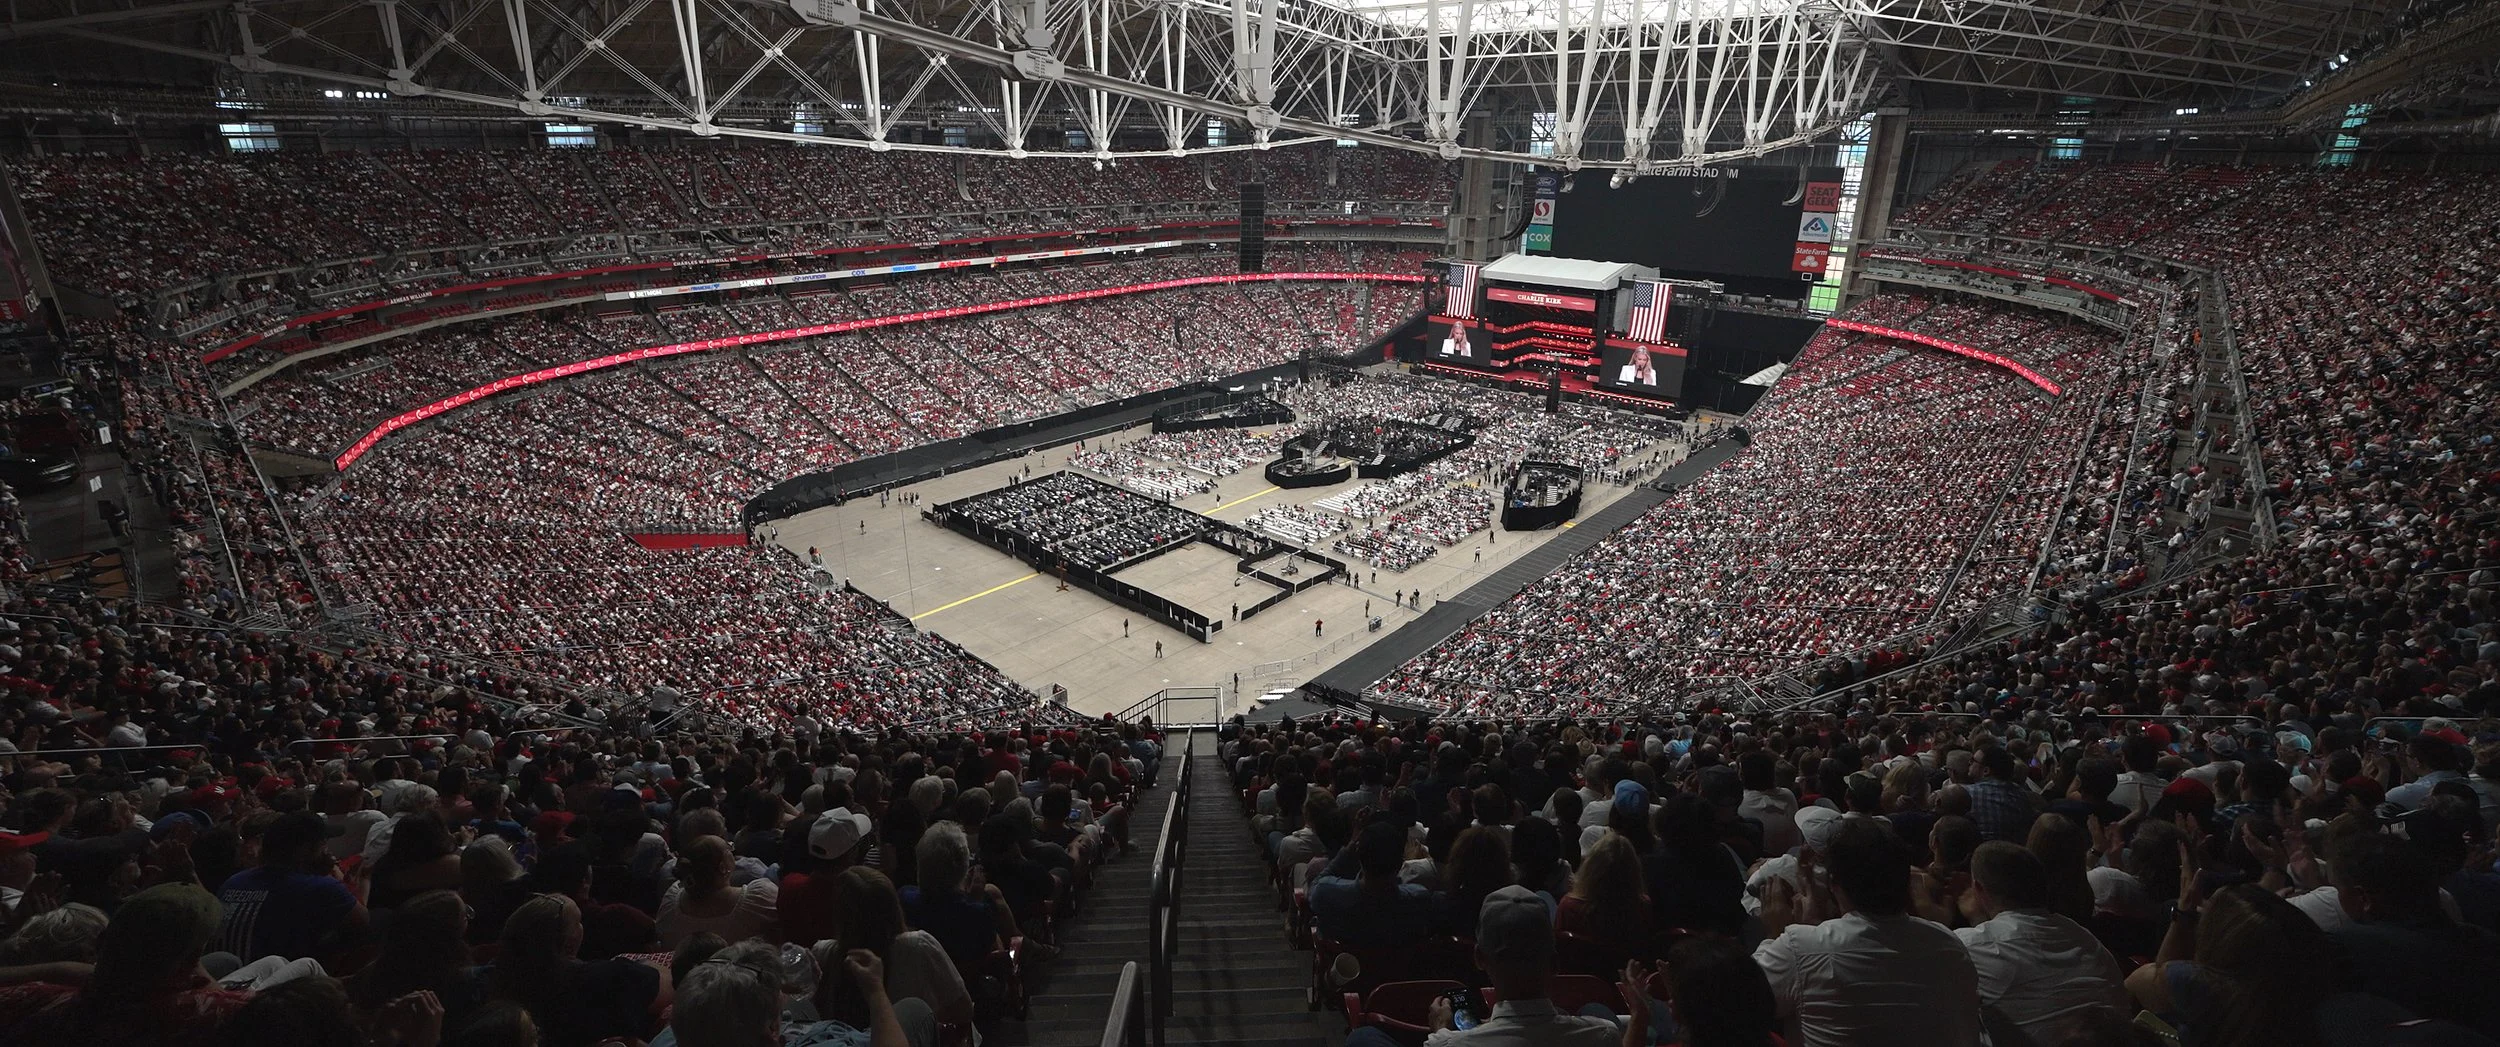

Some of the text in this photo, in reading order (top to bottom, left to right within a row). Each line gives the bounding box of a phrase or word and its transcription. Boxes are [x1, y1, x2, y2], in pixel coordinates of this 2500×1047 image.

[1692, 167, 1739, 179] STADM
[1811, 187, 1836, 196] SEAT
[1807, 197, 1835, 206] GEEK
[1529, 233, 1551, 242] COX
[410, 291, 433, 300] WILLIAMS
[1517, 294, 1544, 303] CHARLIE
[224, 889, 269, 901] FREEDOM
